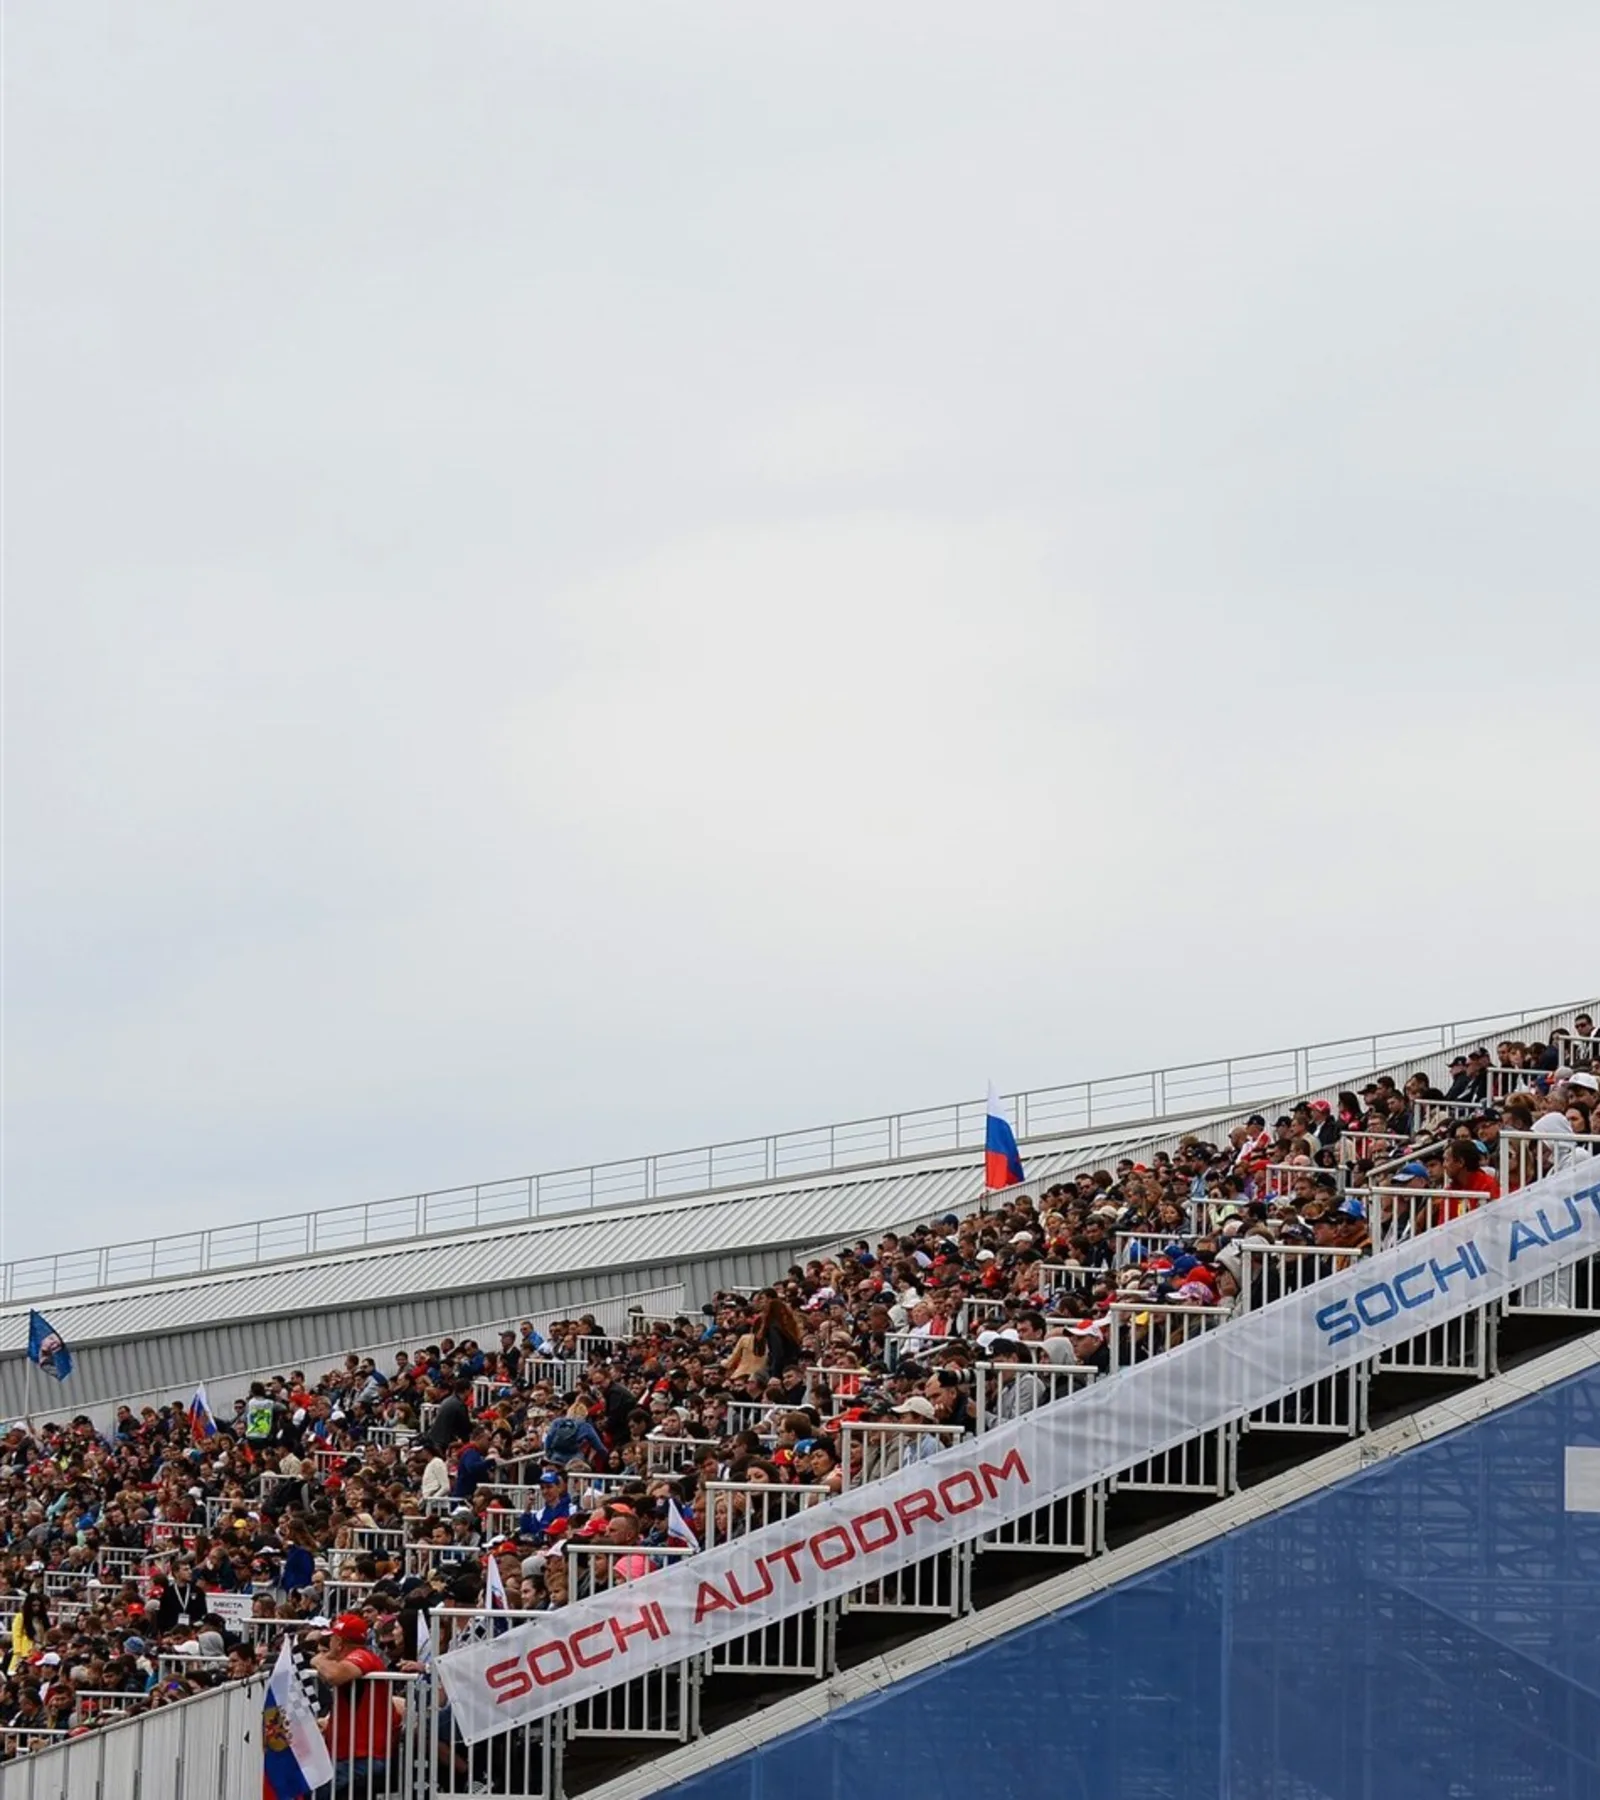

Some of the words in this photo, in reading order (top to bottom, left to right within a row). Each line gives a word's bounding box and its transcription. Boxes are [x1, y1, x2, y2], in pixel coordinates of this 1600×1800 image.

[1315, 1241, 1488, 1345] SOCHI
[486, 1601, 670, 1704] SOCHI
[694, 1449, 1030, 1623] AUTODROM
